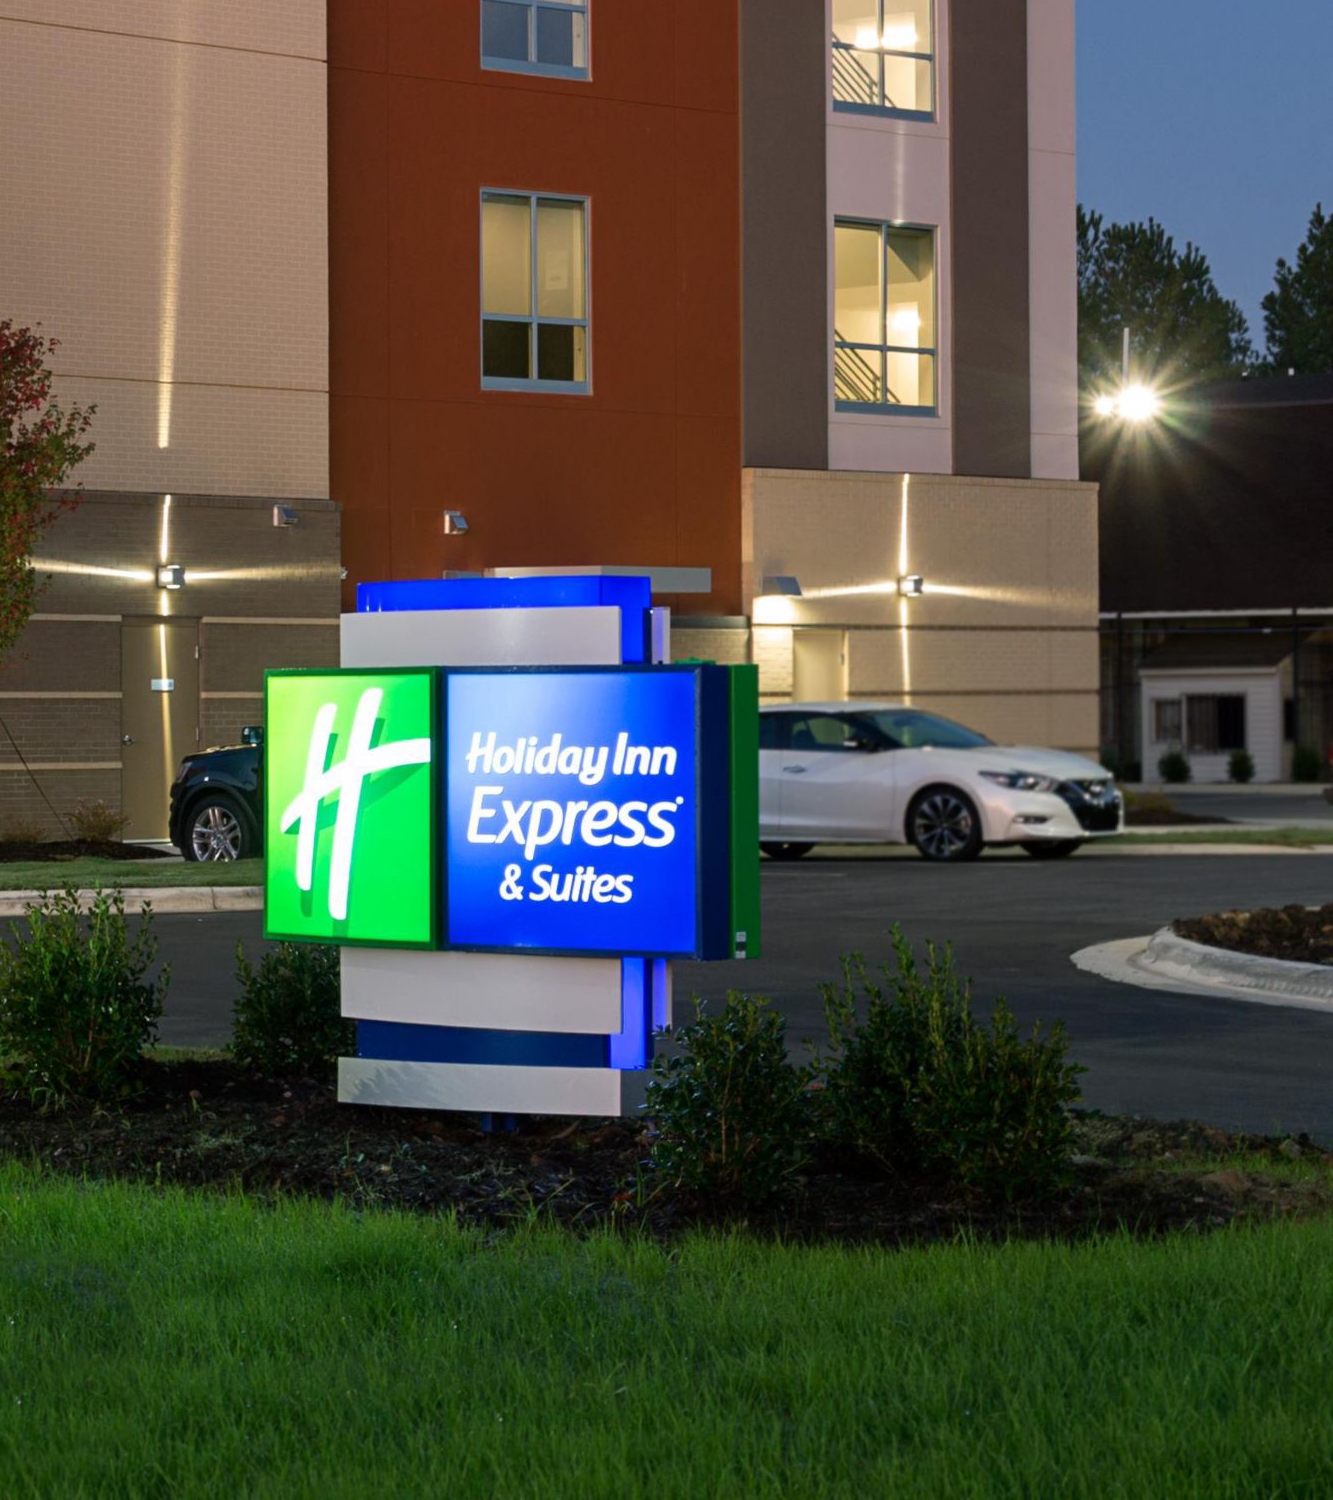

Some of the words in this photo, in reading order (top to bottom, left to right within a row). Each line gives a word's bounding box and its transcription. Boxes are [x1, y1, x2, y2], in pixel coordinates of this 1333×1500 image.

[465, 732, 609, 785] Holiday
[612, 732, 677, 775] Inn
[467, 786, 678, 861] Express
[499, 863, 524, 901] &
[528, 864, 634, 903] Suites
